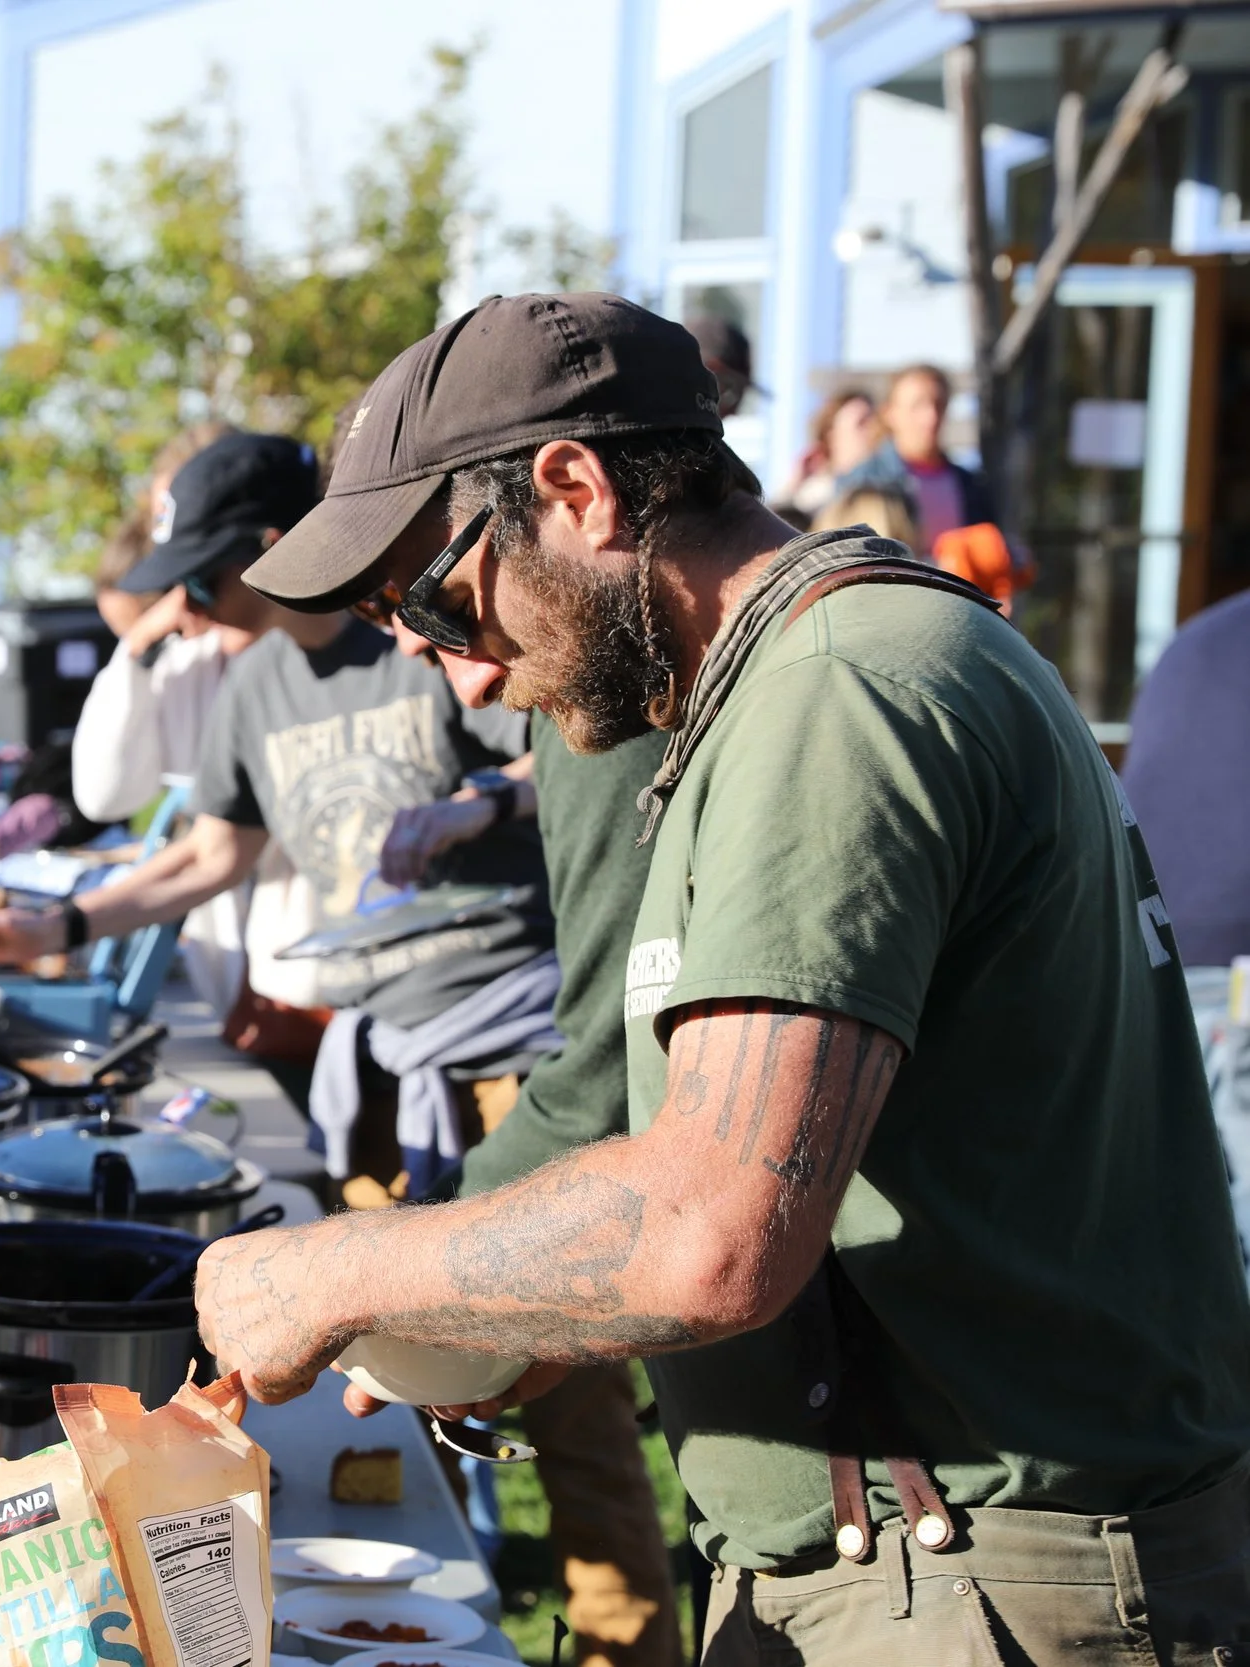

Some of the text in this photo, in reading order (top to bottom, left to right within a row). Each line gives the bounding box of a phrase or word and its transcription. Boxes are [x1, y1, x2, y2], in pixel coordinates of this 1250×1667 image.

[146, 1511, 230, 1539] Nutrition Facts
[160, 1546, 231, 1578] Calories 140
